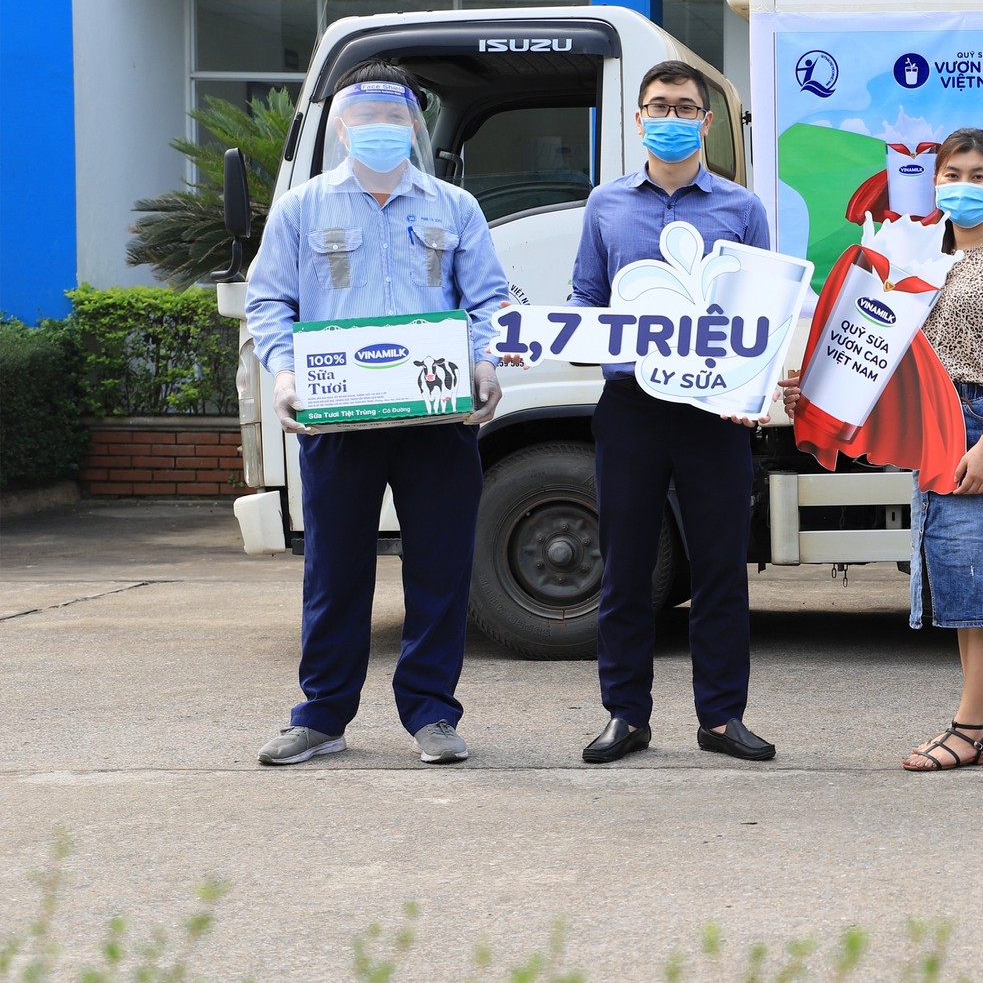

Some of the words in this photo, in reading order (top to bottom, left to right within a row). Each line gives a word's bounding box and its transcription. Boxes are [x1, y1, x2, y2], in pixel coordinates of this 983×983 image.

[479, 38, 572, 52] ISUZU
[858, 297, 896, 325] VINAMILK
[495, 310, 582, 362] 1,7
[598, 303, 770, 369] TRIỆU
[840, 320, 867, 339] QUỸ
[866, 334, 889, 354] SỮA
[309, 353, 345, 366] 100%
[357, 348, 407, 361] VINAMILK
[831, 330, 863, 356] VƯƠN
[864, 350, 888, 369] CAO
[307, 368, 335, 381] Sữa
[826, 345, 852, 366] VIỆT
[852, 361, 879, 382] NAM
[308, 379, 347, 395] Tươi
[650, 367, 675, 386] LY
[680, 370, 727, 389] SỮA
